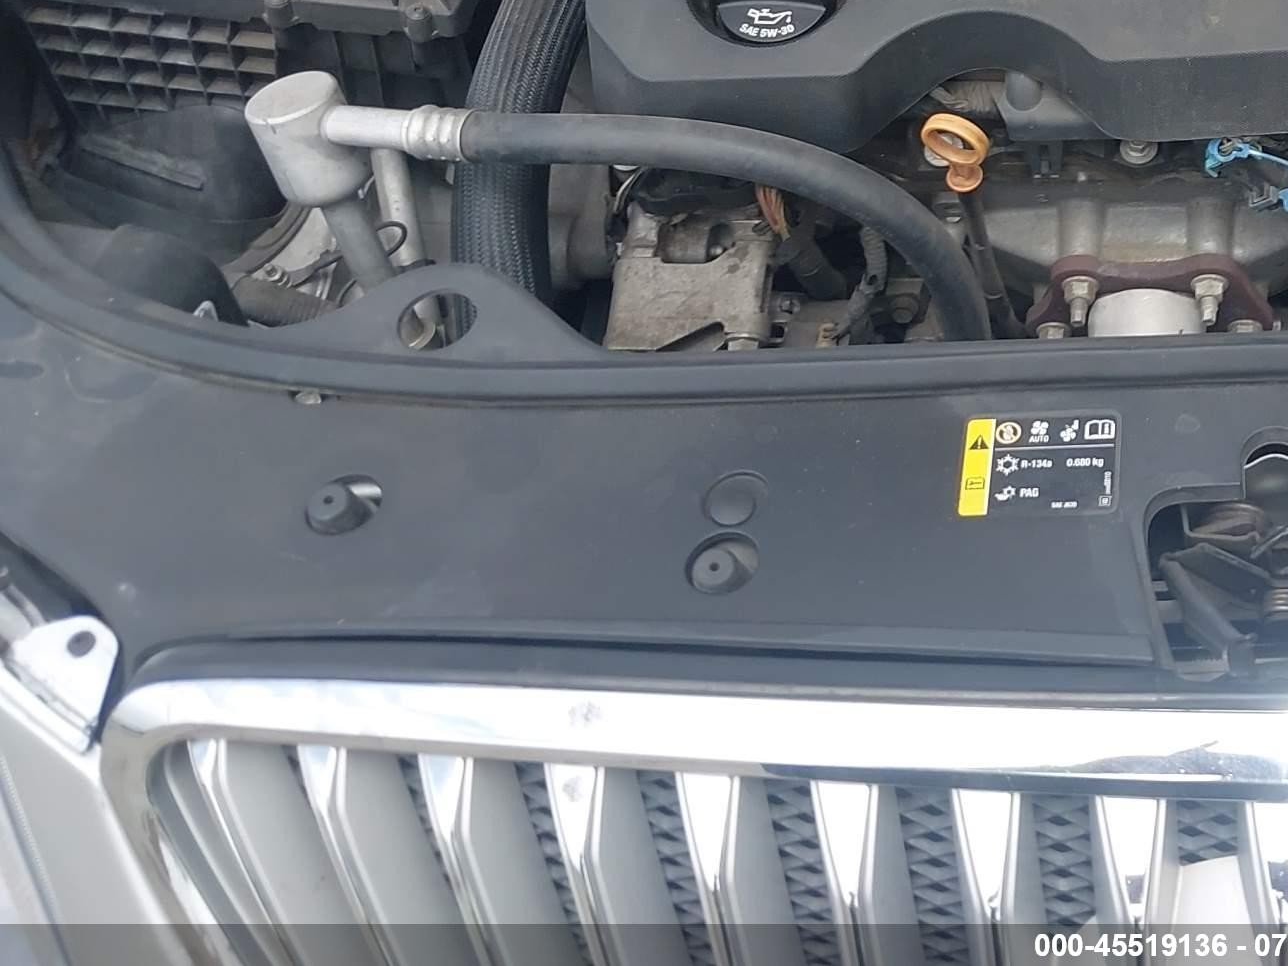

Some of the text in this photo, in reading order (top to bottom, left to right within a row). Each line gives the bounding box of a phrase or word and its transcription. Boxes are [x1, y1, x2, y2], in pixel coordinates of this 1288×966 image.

[739, 23, 795, 38] SAE 5W-30
[1029, 435, 1049, 443] AUTO
[1092, 457, 1104, 467] kg
[1019, 488, 1039, 497] PAG
